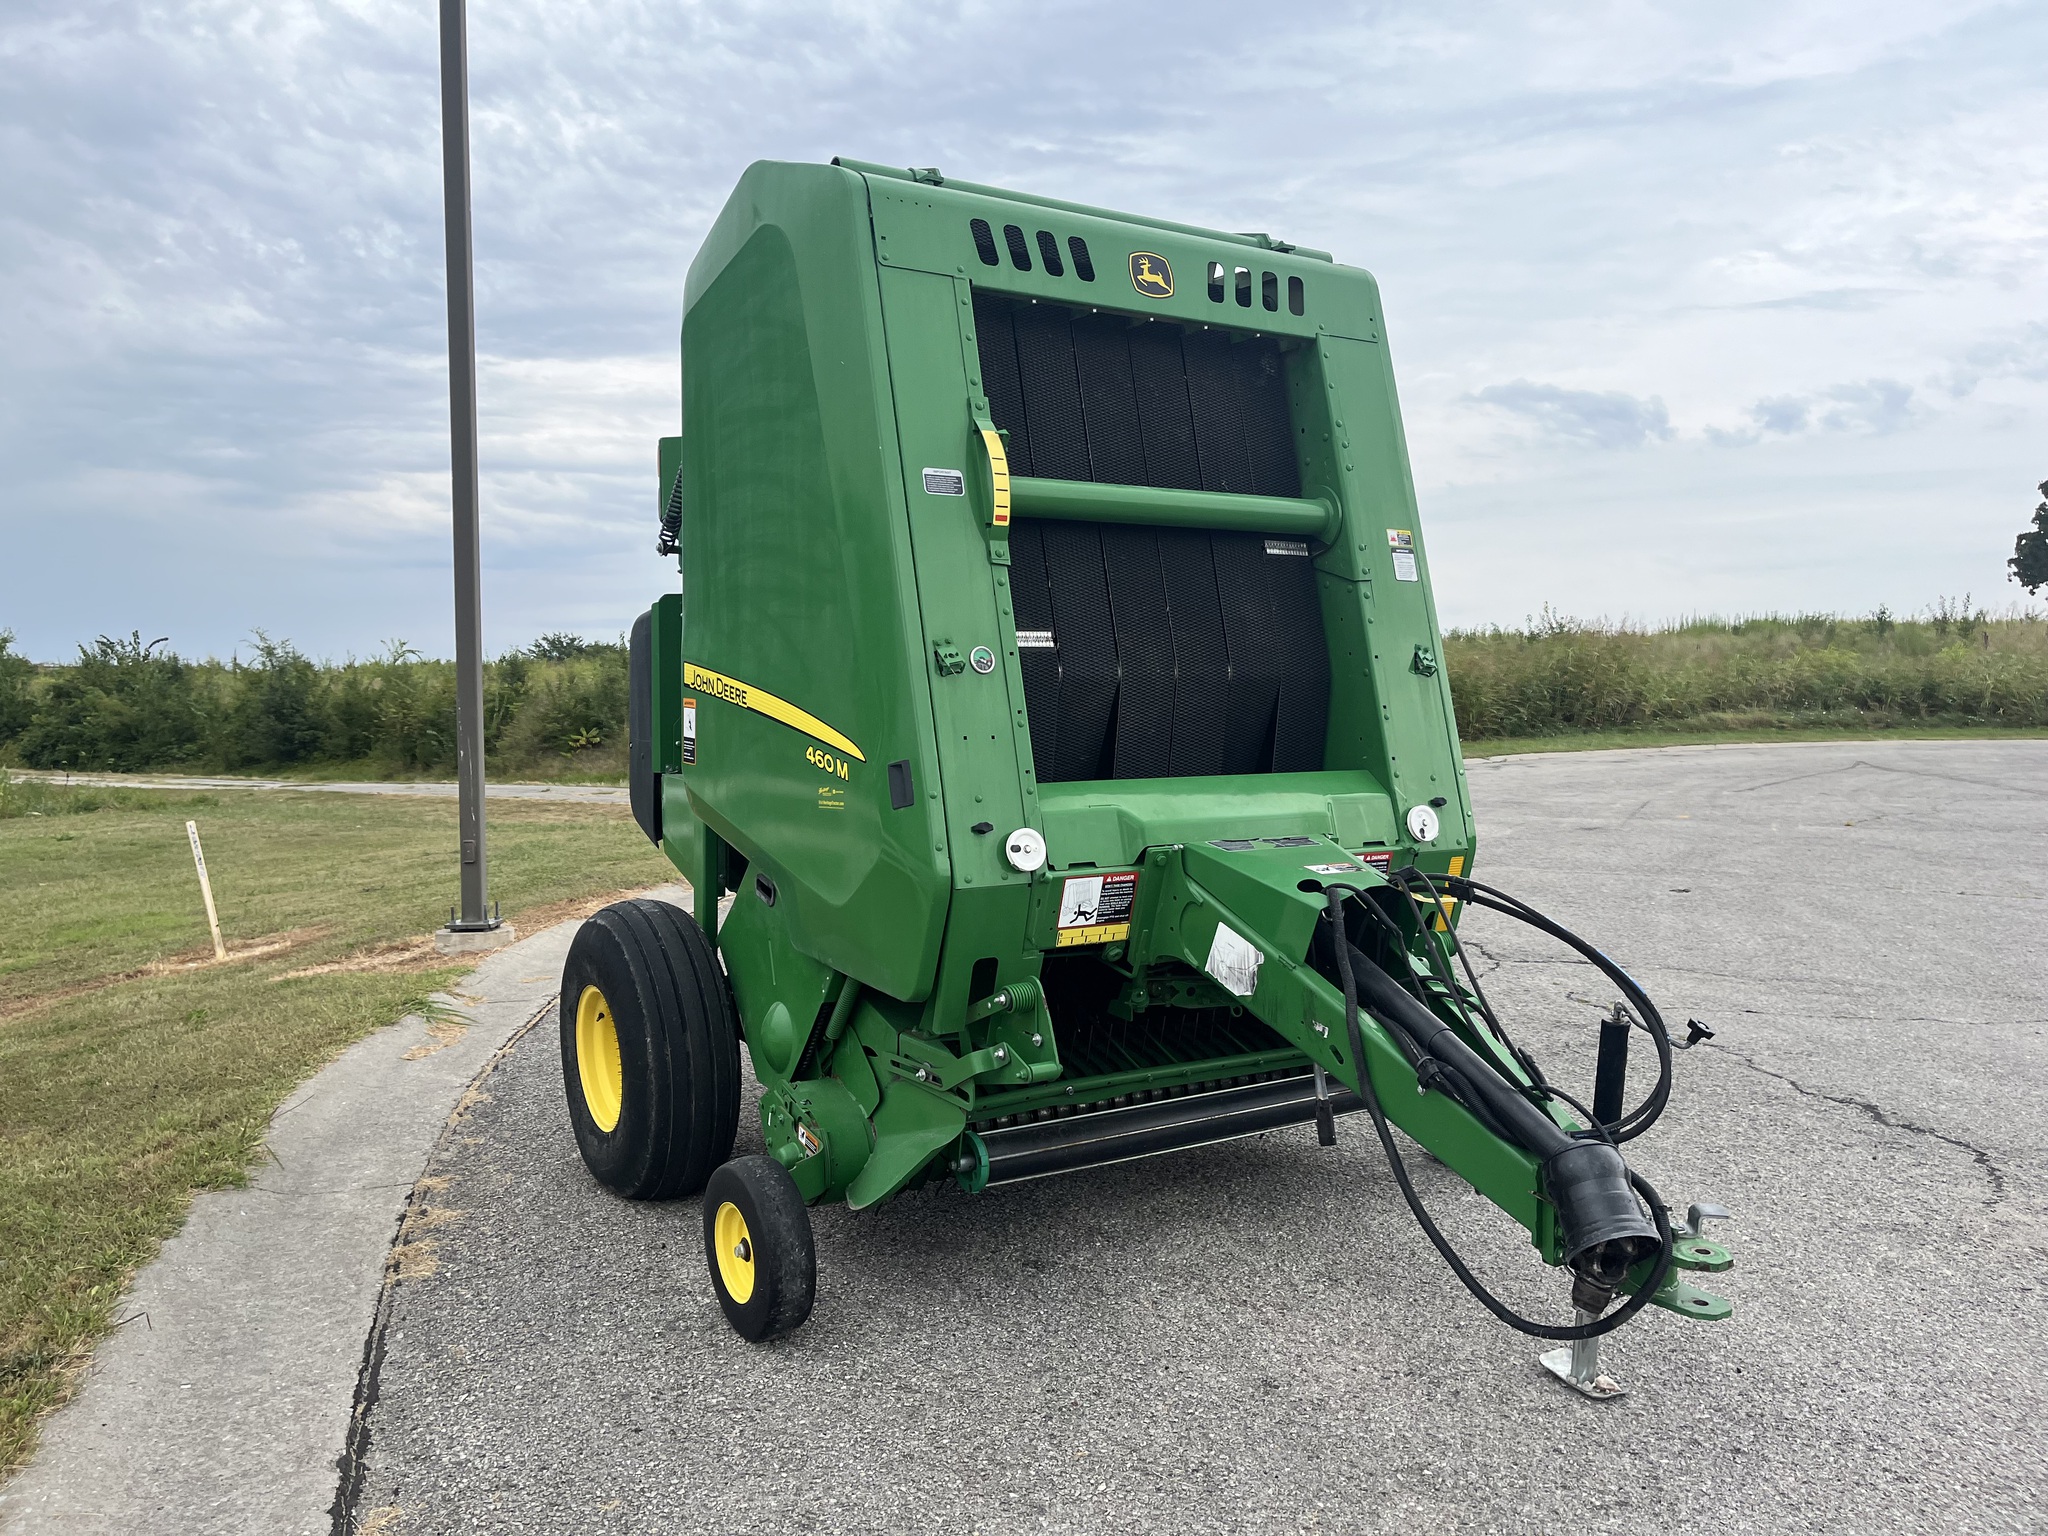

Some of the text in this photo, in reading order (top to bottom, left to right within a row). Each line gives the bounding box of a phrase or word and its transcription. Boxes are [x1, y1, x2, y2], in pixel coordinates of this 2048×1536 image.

[690, 669, 748, 706] JOHN DEERE
[805, 745, 849, 782] 460 M
[1112, 874, 1135, 882] DANGER
